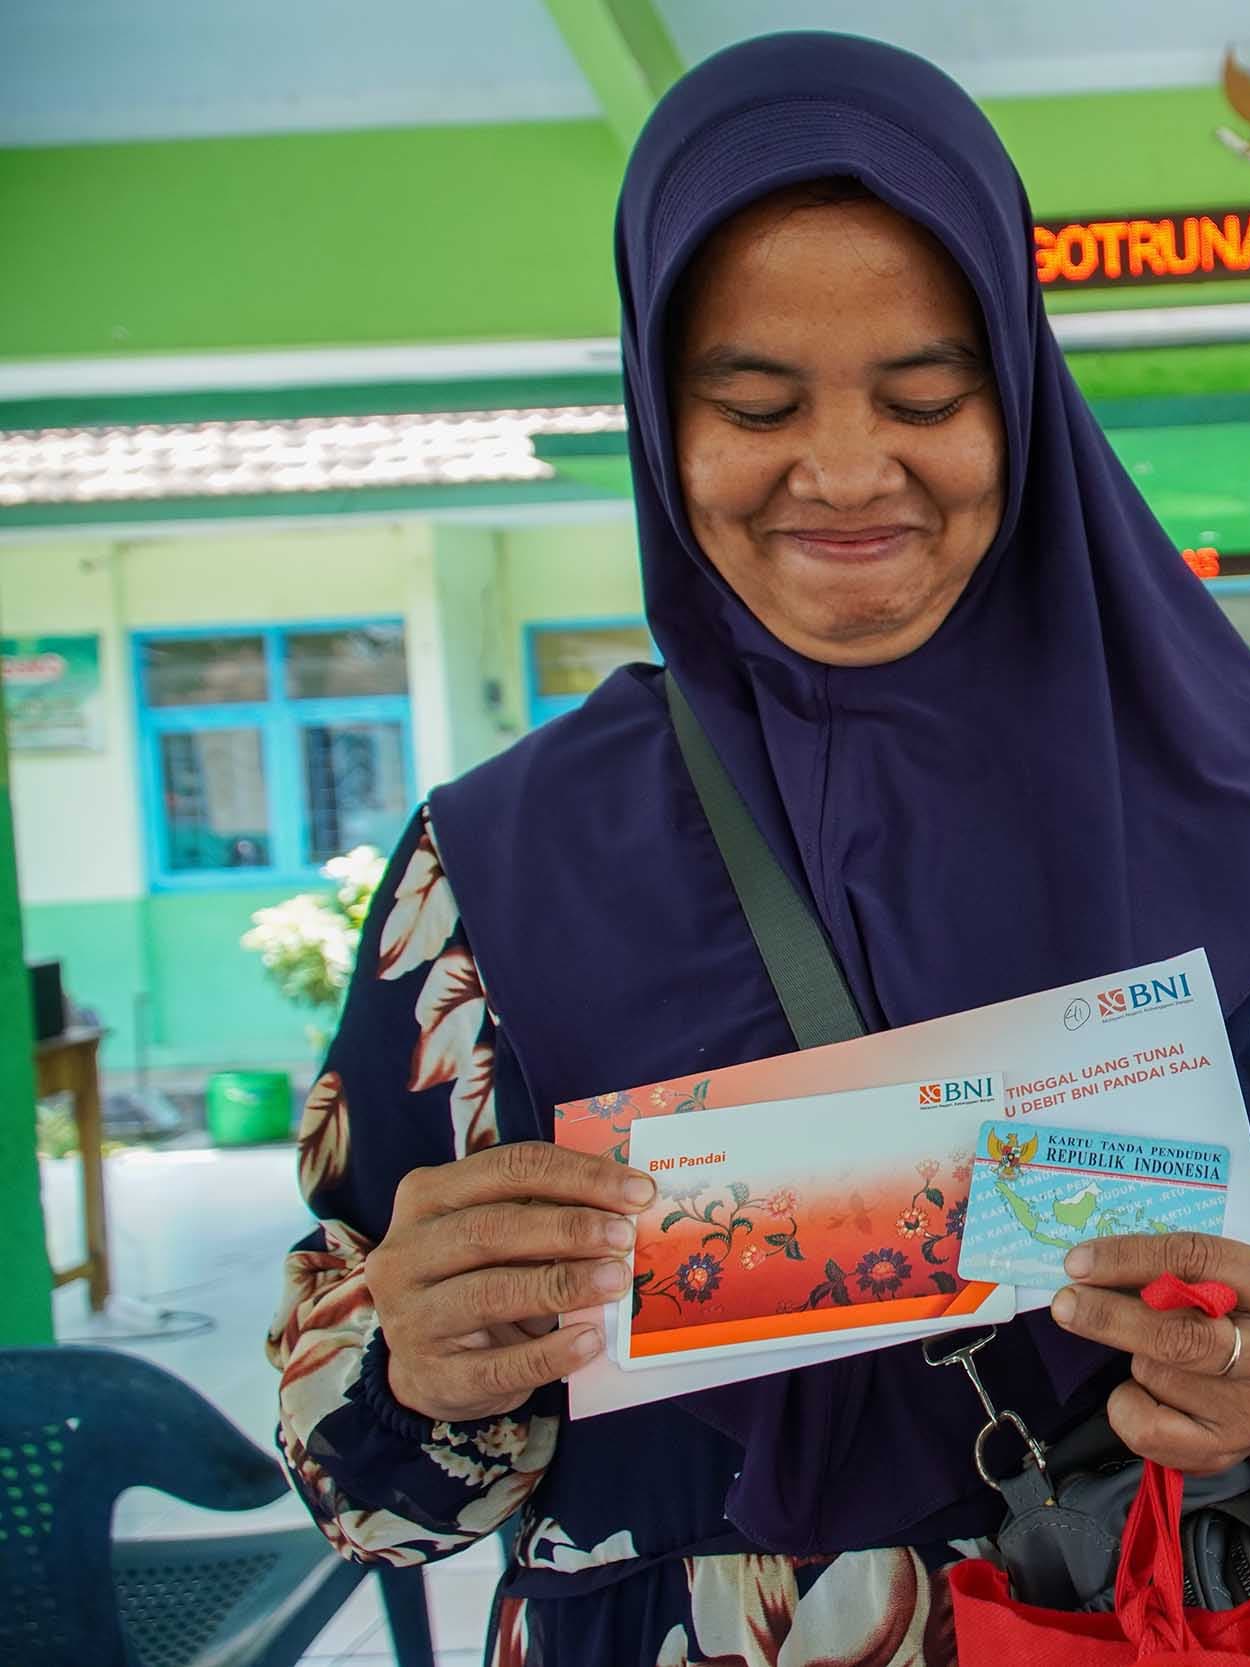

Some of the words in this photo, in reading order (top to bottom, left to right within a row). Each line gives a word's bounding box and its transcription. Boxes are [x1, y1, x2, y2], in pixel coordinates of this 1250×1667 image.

[1128, 972, 1192, 1008] BNI
[1006, 1072, 1078, 1100] TINGGAL
[1082, 1057, 1130, 1079] UANG
[1134, 1043, 1185, 1065] TUNAI
[1021, 1092, 1066, 1114] DEBIT
[1071, 1083, 1100, 1100] BNI
[1103, 1066, 1165, 1091] PANDAI
[1169, 1055, 1211, 1074] SAJA
[944, 1077, 993, 1102] BNI
[649, 1158, 675, 1172] BNI
[679, 1151, 726, 1168] Pandai
[1046, 1147, 1126, 1170] REPUBLIK
[1134, 1157, 1220, 1180] INDONESIA
[1048, 1135, 1094, 1149] KARTU
[1102, 1141, 1144, 1155] TANDA
[1151, 1146, 1222, 1163] PENDUDUK
